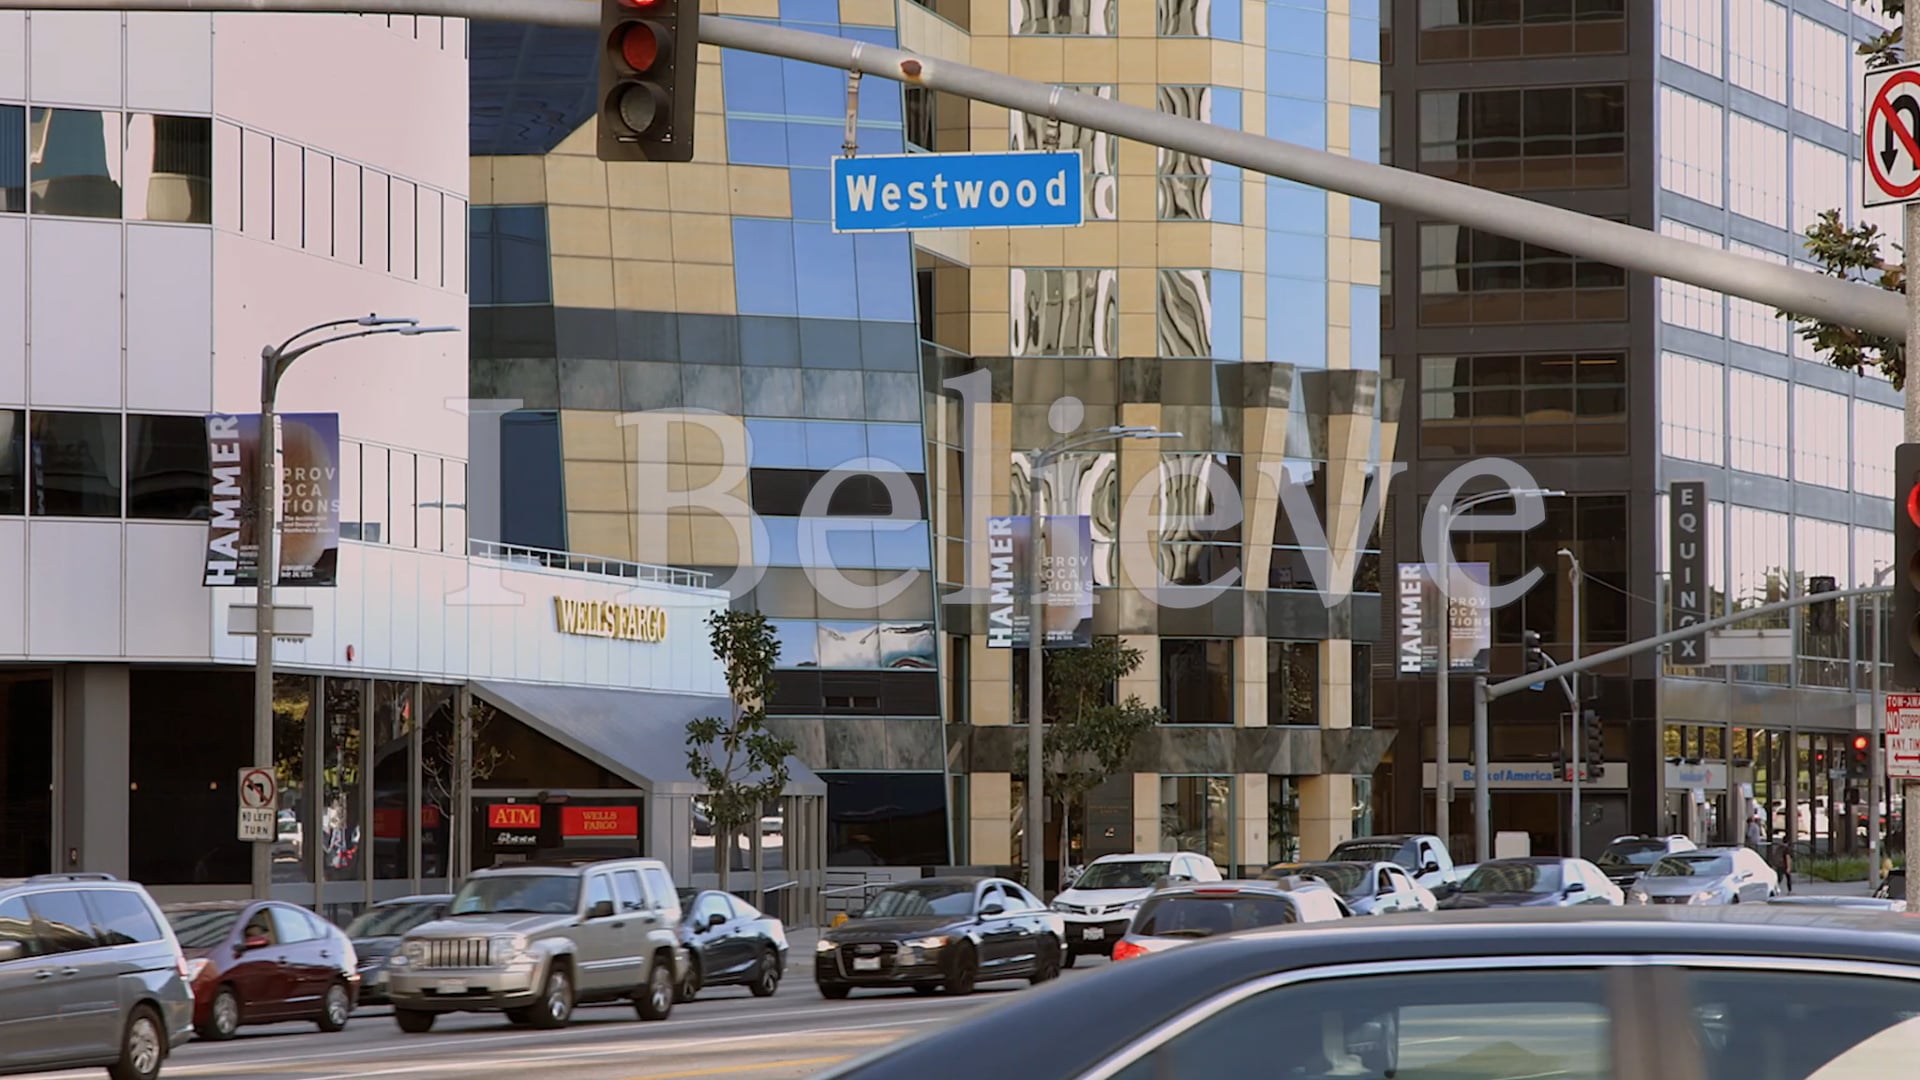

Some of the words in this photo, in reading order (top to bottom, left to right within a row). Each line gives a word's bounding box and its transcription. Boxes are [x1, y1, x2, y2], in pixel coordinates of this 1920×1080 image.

[846, 169, 1067, 212] Westwood
[283, 467, 336, 481] PROV
[283, 483, 322, 497] OCA
[205, 415, 241, 585] HAMMER
[283, 499, 340, 513] TIONS
[1044, 556, 1089, 567] PROV
[988, 517, 1014, 648] HAMMER
[554, 595, 616, 638] WELLS
[616, 603, 667, 643] FARGO
[1401, 564, 1422, 673] HAMMER
[1887, 711, 1899, 732] NO
[1506, 769, 1552, 781] America
[253, 813, 272, 823] LEFT
[495, 809, 536, 825] ATM
[582, 811, 617, 821] WELLS
[245, 826, 269, 835] TURN
[584, 821, 617, 831] FARGO
